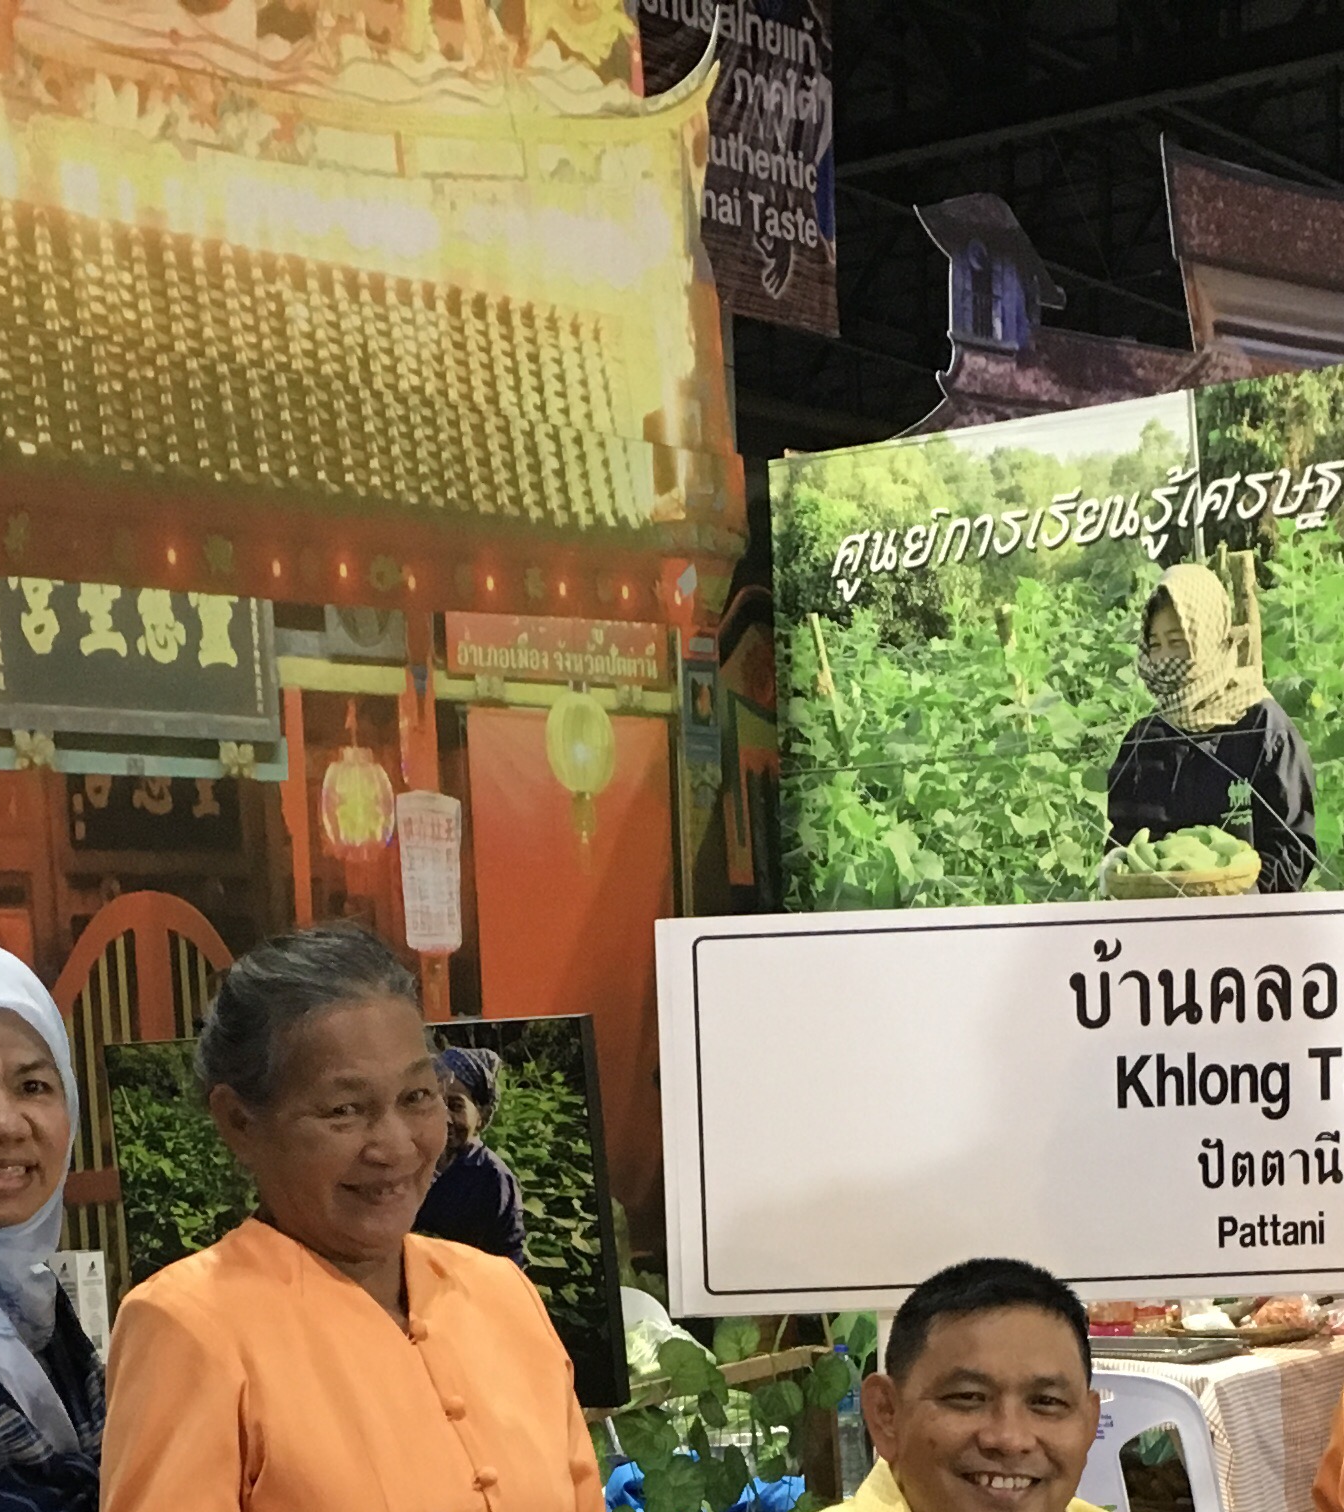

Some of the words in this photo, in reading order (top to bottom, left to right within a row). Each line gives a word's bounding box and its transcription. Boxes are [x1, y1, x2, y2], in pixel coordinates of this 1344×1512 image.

[707, 132, 818, 194] uthentic
[747, 190, 818, 249] Taste
[1117, 1052, 1291, 1120] Khlong
[1197, 1130, 1344, 1189] ปัตตานี
[1218, 1211, 1325, 1249] Pattani
